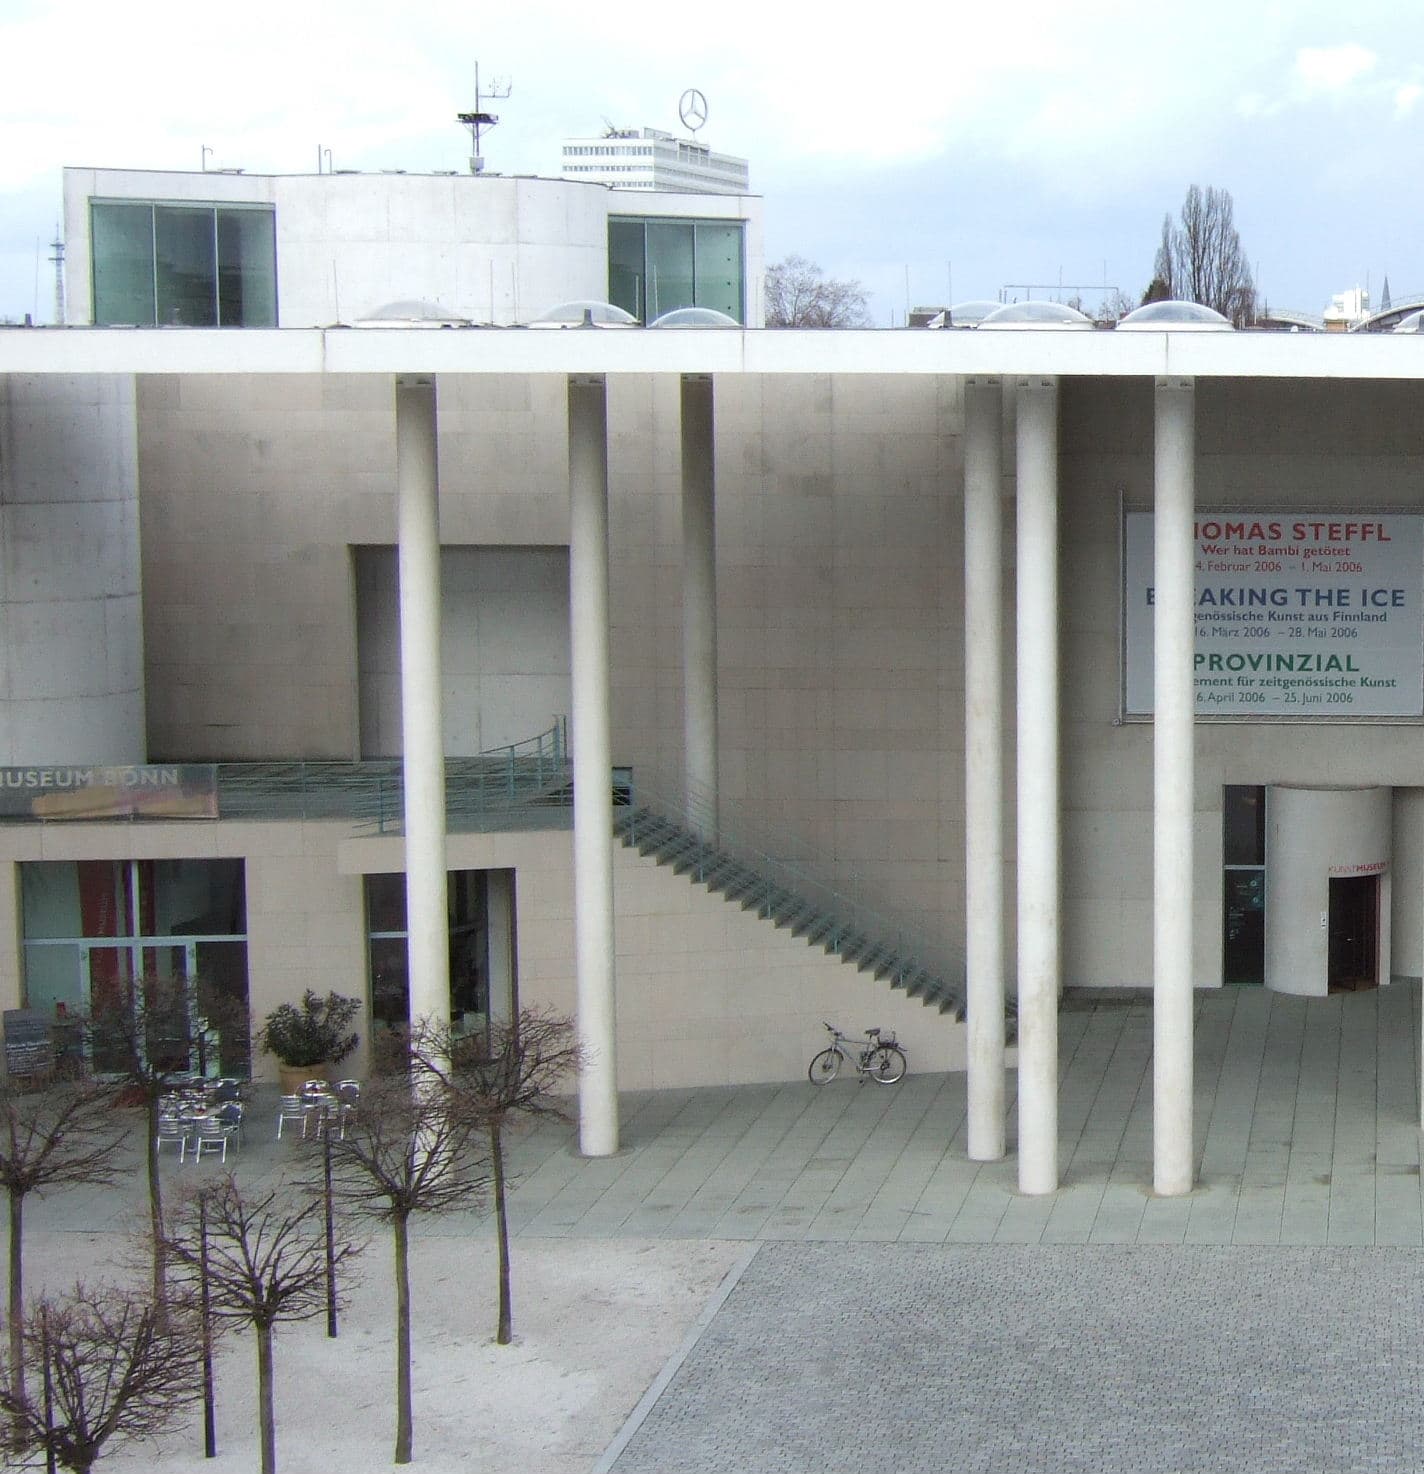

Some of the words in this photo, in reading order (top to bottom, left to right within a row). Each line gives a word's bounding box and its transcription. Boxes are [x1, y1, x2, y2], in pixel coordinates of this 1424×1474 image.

[1194, 522, 1282, 541] OMAS
[1292, 523, 1392, 541] STEFFL
[1202, 545, 1229, 555] Wer
[1233, 545, 1254, 556] hat
[1258, 545, 1299, 556] Bambi
[1303, 546, 1351, 559] getötet
[1207, 561, 1251, 572] Februar
[1254, 561, 1282, 572] 2006
[1312, 562, 1332, 572] Mai
[1335, 562, 1363, 573] 2006
[1146, 587, 1288, 606] BAKING
[1295, 588, 1351, 606] THE
[1361, 588, 1405, 607] ICE
[1194, 610, 1264, 625] enössische
[1268, 610, 1304, 622] Kunst
[1308, 613, 1329, 622] aus
[1332, 611, 1388, 622] Finnland
[1211, 626, 1240, 637] März
[1243, 626, 1271, 638] 2006
[1288, 626, 1305, 638] 28.
[1307, 627, 1327, 638] Mai
[1330, 627, 1358, 638] 2006
[1194, 653, 1360, 672] PROVINZIAL
[1237, 675, 1256, 687] für
[1259, 676, 1356, 690] zeitgenössische
[1359, 677, 1397, 688] Kunst
[1207, 691, 1235, 705] April
[1238, 692, 1266, 703] 2006
[1284, 692, 1301, 703] 25.
[1301, 692, 1323, 706] Juni
[1326, 692, 1354, 703] 2006
